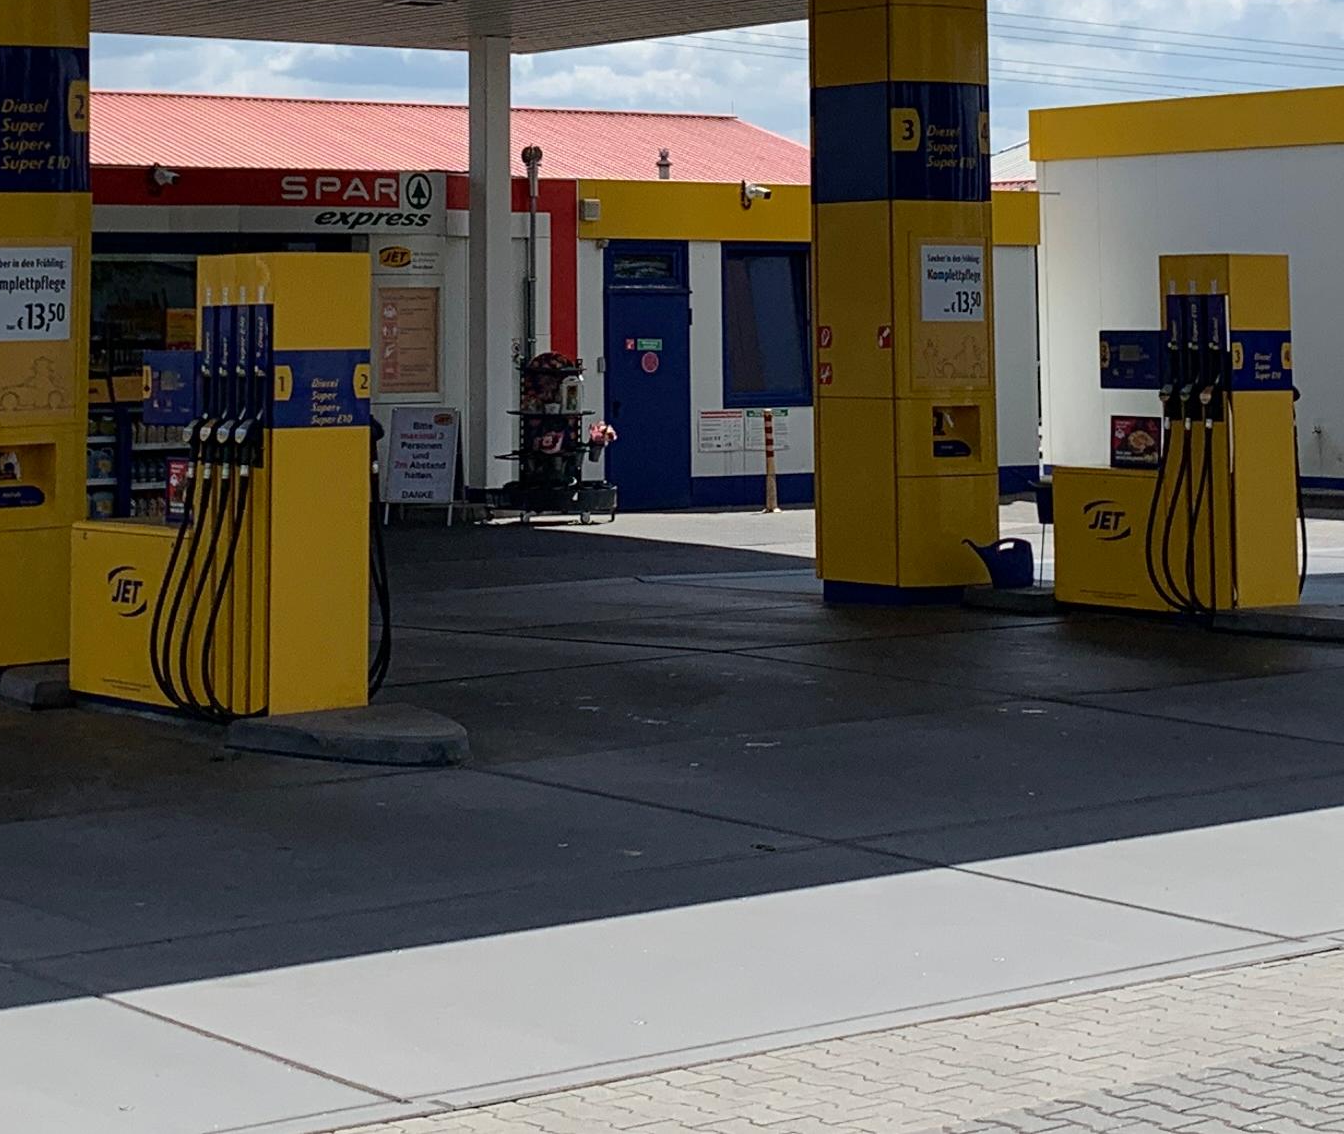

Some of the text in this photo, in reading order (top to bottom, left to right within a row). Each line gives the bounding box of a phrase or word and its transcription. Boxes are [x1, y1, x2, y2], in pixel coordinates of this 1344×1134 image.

[0, 98, 50, 114] Diesel
[74, 94, 85, 119] 2
[0, 117, 45, 137] Super
[902, 119, 914, 140] 3
[0, 136, 52, 155] Super+
[927, 140, 958, 155] Super
[0, 155, 71, 175] Super E10
[927, 155, 959, 170] Super
[281, 176, 398, 202] SPAR
[315, 211, 431, 229] express
[12, 258, 19, 267] in
[21, 258, 34, 267] den
[383, 251, 409, 264] JET
[928, 268, 981, 283] Komplettpflege
[278, 376, 285, 392] 1
[360, 373, 368, 389] 2
[413, 422, 433, 430] Bitte
[401, 441, 443, 450] Personen
[412, 451, 430, 459] und
[409, 460, 446, 469] Abstand
[401, 490, 433, 499] DANKE
[1089, 511, 1125, 530] JET
[112, 578, 143, 604] JET
